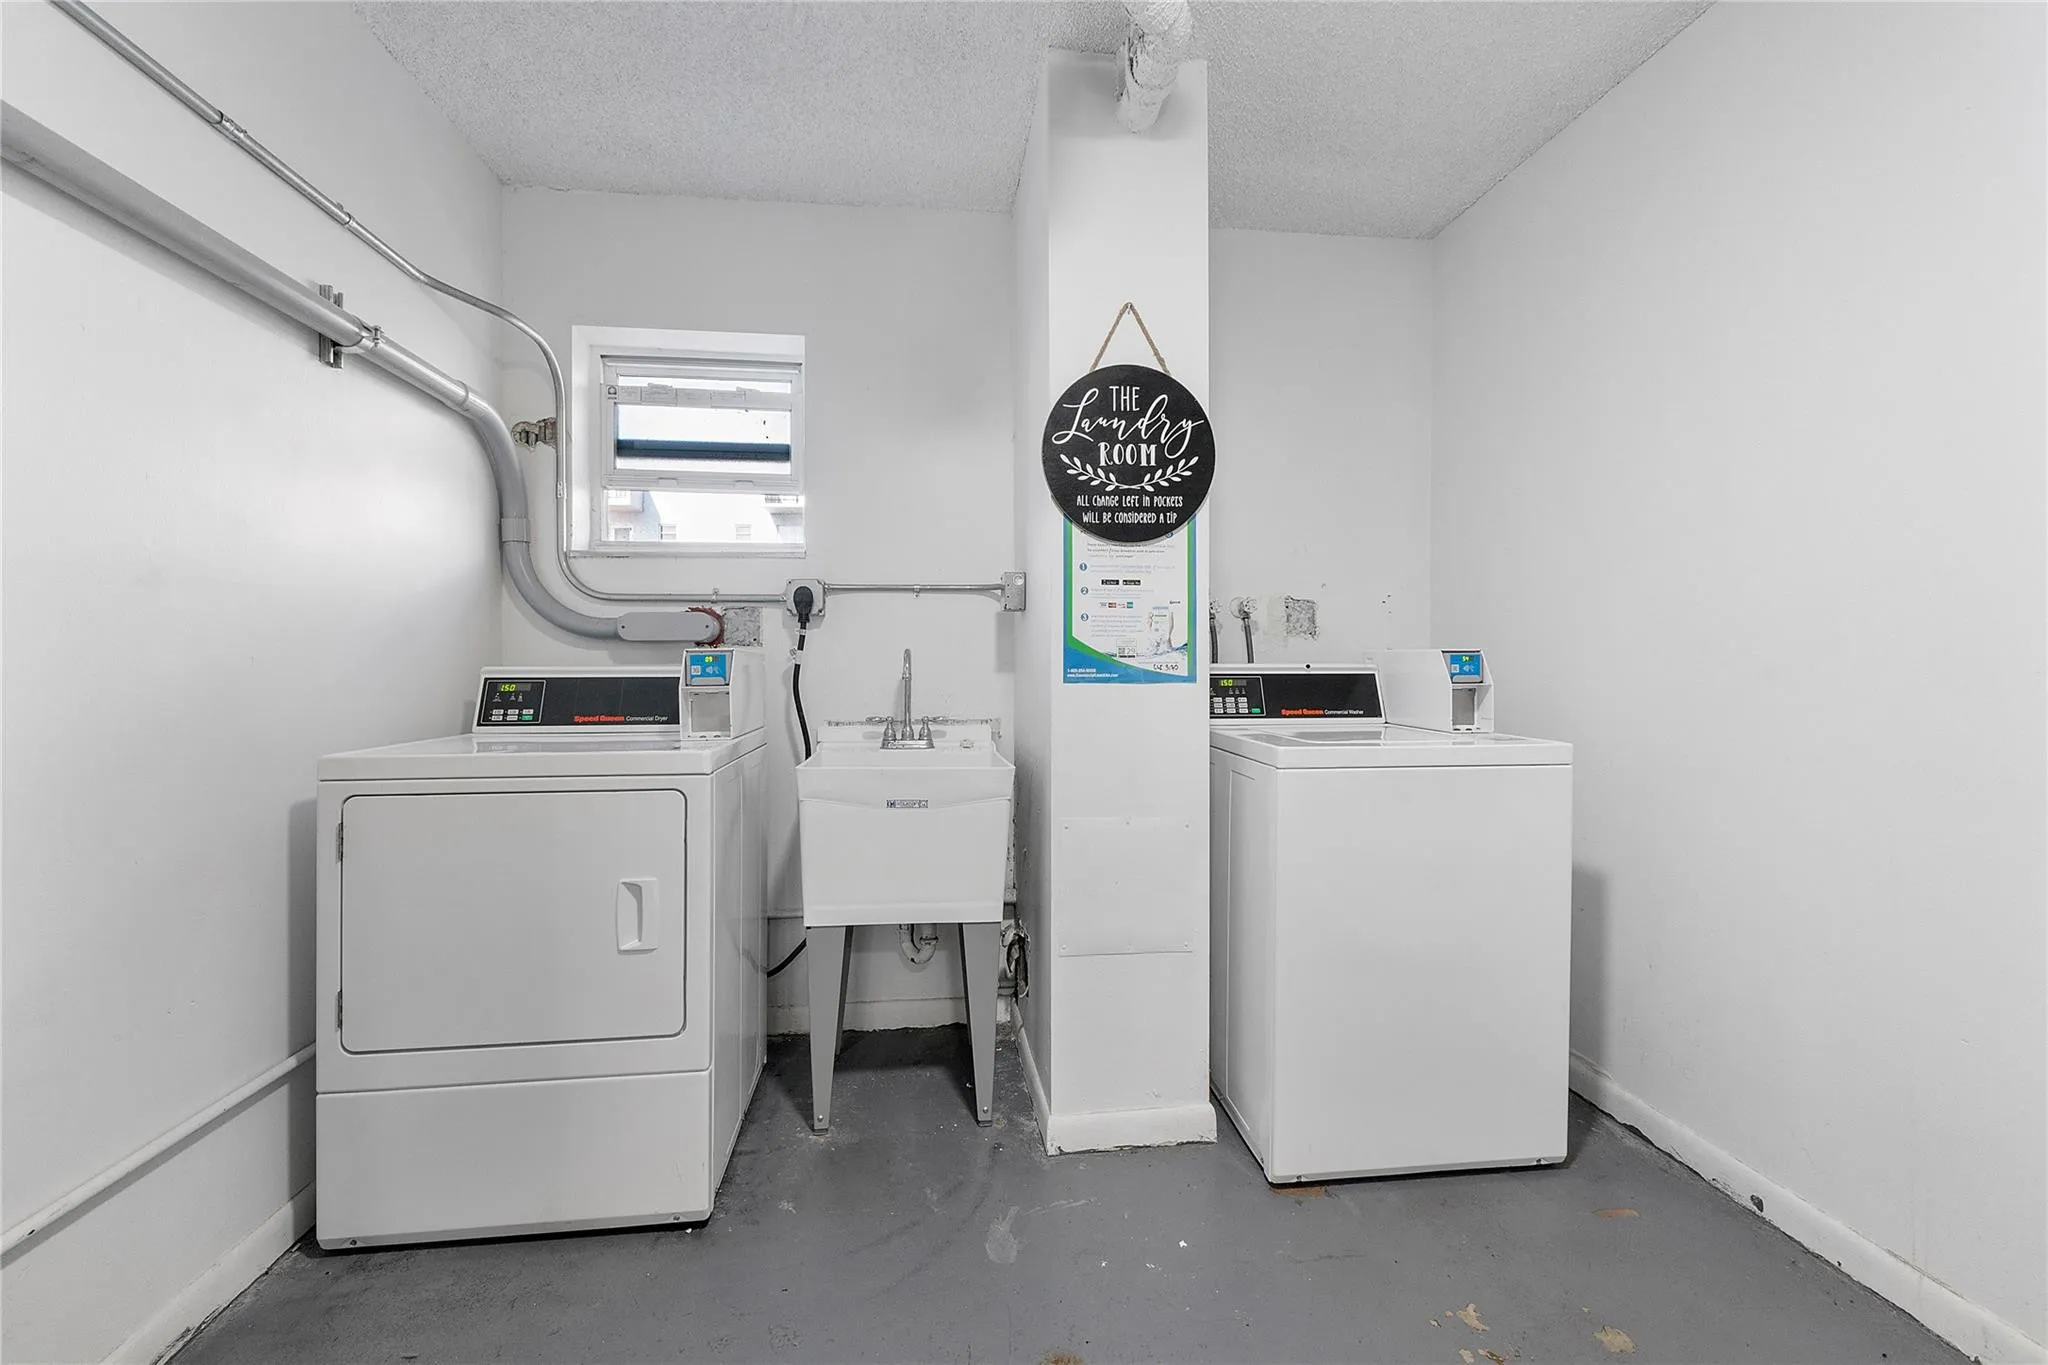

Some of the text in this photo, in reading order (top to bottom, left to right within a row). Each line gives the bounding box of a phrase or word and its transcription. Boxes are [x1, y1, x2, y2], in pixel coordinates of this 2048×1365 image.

[1109, 385, 1141, 412] THE
[1051, 387, 1205, 459] Laundry
[1098, 441, 1158, 467] ROOM
[1076, 494, 1090, 507] ALL
[1159, 512, 1165, 524] A
[574, 715, 599, 723] Speed
